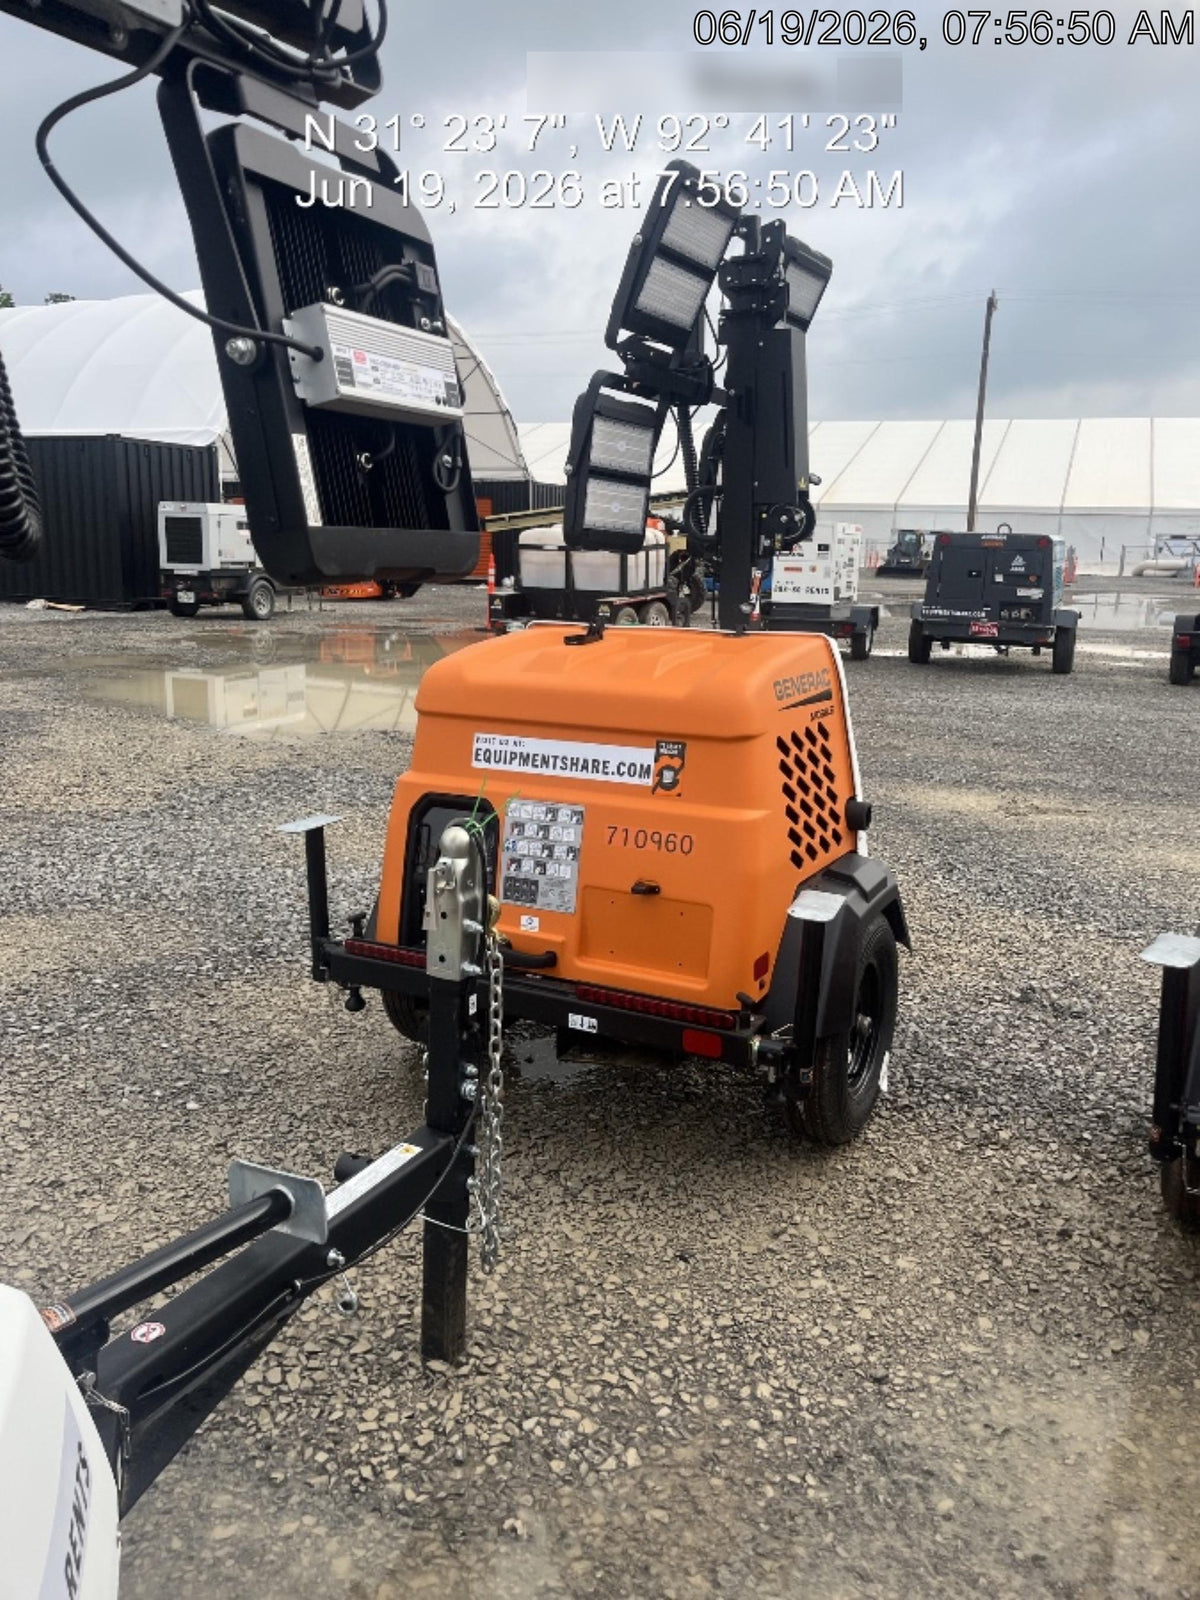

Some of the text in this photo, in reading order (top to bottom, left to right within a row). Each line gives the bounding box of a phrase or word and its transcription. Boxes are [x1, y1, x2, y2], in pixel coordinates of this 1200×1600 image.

[773, 667, 832, 701] GENERAC
[473, 747, 653, 780] EQUIPMENTSHARE.COM
[606, 825, 694, 856] 710960
